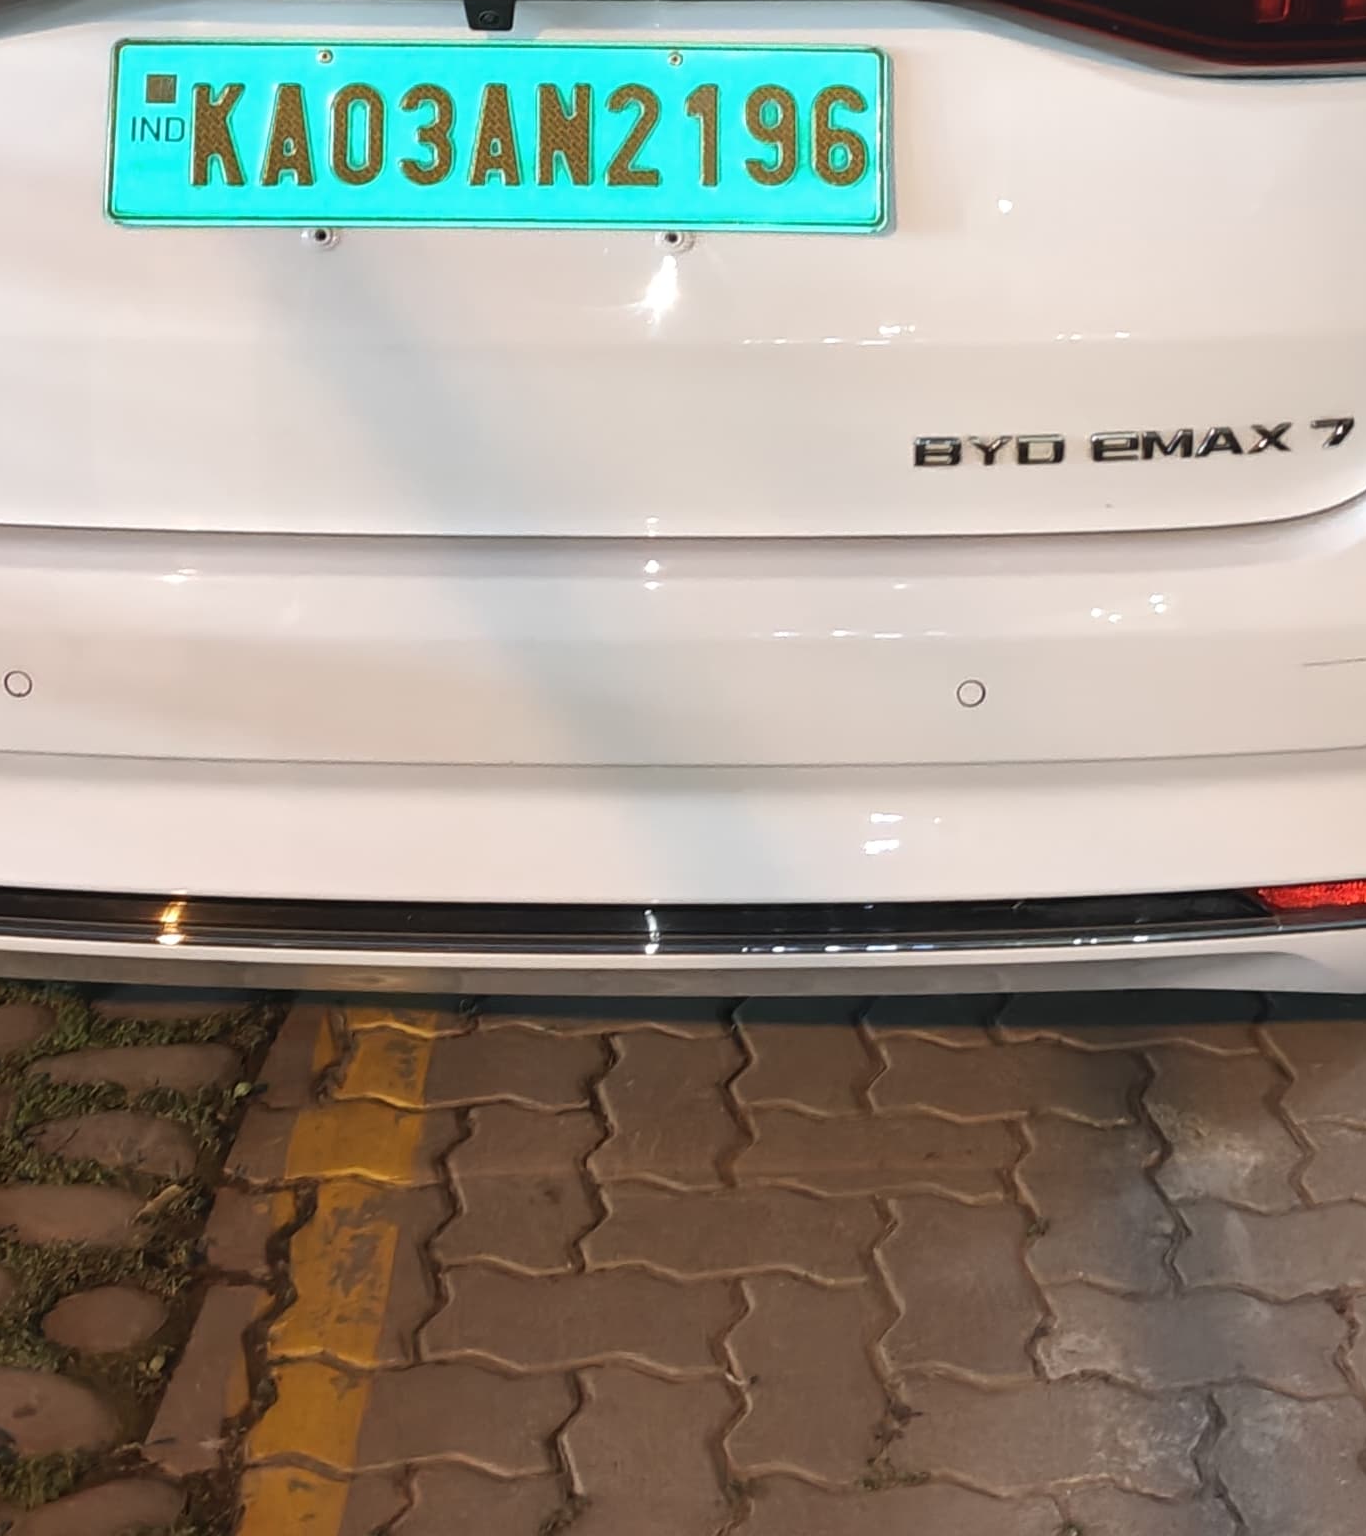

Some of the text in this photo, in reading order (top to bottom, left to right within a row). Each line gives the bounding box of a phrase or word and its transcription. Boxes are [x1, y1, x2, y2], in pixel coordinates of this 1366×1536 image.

[130, 82, 872, 188] IND KA03AN2196
[913, 432, 1066, 467] BYD
[1309, 417, 1355, 449] 7
